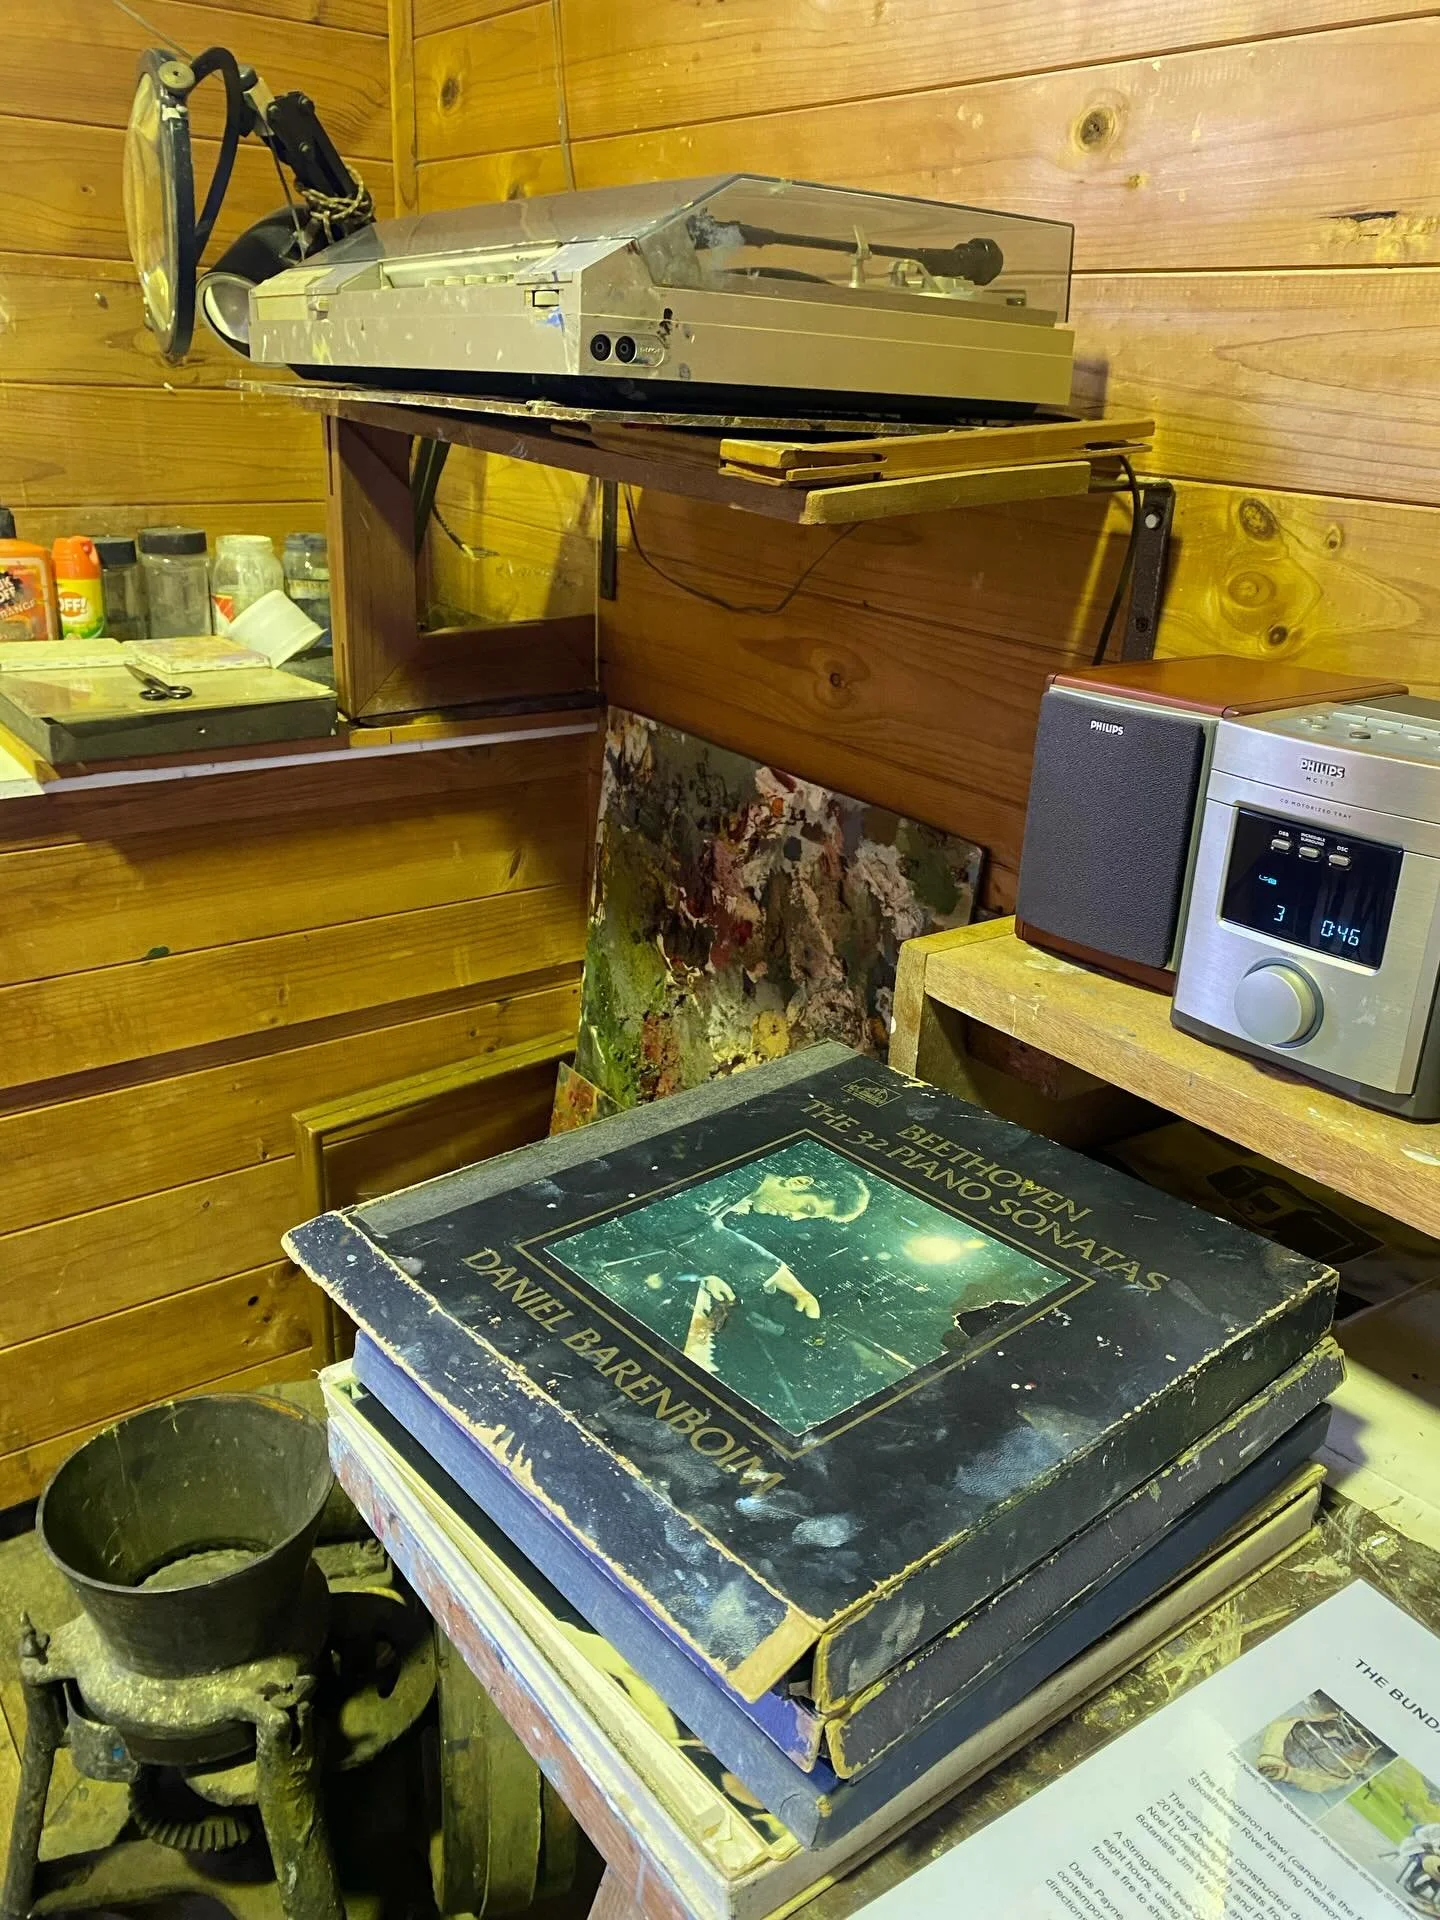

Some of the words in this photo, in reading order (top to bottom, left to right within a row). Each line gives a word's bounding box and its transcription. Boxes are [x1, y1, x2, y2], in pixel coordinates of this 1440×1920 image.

[60, 597, 87, 614] OFF!
[1090, 720, 1124, 736] PHILIPS
[1301, 759, 1345, 778] PHILIPS
[1291, 801, 1331, 815] MOTORIZED
[1334, 811, 1352, 820] TRAY
[1336, 845, 1349, 853] DSC
[1273, 904, 1286, 922] 3
[1320, 920, 1361, 946] 0:46
[800, 1099, 861, 1134] THE
[844, 1129, 889, 1152] 32
[887, 1144, 992, 1201] PIANO
[988, 1198, 1171, 1292] SONATAS
[896, 1124, 1093, 1223] BEETHOVEN
[462, 1246, 575, 1334] DANIEL
[560, 1327, 786, 1496] BARENBOIM
[1355, 1658, 1390, 1688] THE
[1389, 1688, 1440, 1733] BUND
[1113, 1831, 1123, 1839] A
[1123, 1839, 1172, 1892] Stringybark
[1136, 1814, 1177, 1856] Botanists
[1177, 1857, 1194, 1874] Jim
[1146, 1806, 1169, 1828] Noel
[1233, 1893, 1255, 1913] and
[1168, 1791, 1186, 1810] The
[1186, 1810, 1214, 1837] canoe
[1235, 1858, 1292, 1911] constructed
[1187, 1777, 1240, 1827] Shoalhaven
[1240, 1827, 1266, 1851] River
[1266, 1852, 1277, 1862] in
[1277, 1862, 1304, 1888] living
[1199, 1769, 1216, 1787] The
[1216, 1787, 1263, 1832] Bundanon
[1264, 1831, 1288, 1855] Nawi
[1288, 1856, 1327, 1891] (canoe)
[1327, 1890, 1337, 1901] is
[1338, 1901, 1354, 1916] the
[1069, 1862, 1095, 1889] Davis
[1092, 1846, 1113, 1868] from
[1112, 1868, 1121, 1877] a
[1120, 1876, 1136, 1892] fire
[1136, 1893, 1147, 1904] to
[1103, 1839, 1126, 1862] eight
[1155, 1892, 1181, 1919] using
[1236, 1879, 1266, 1907] artists
